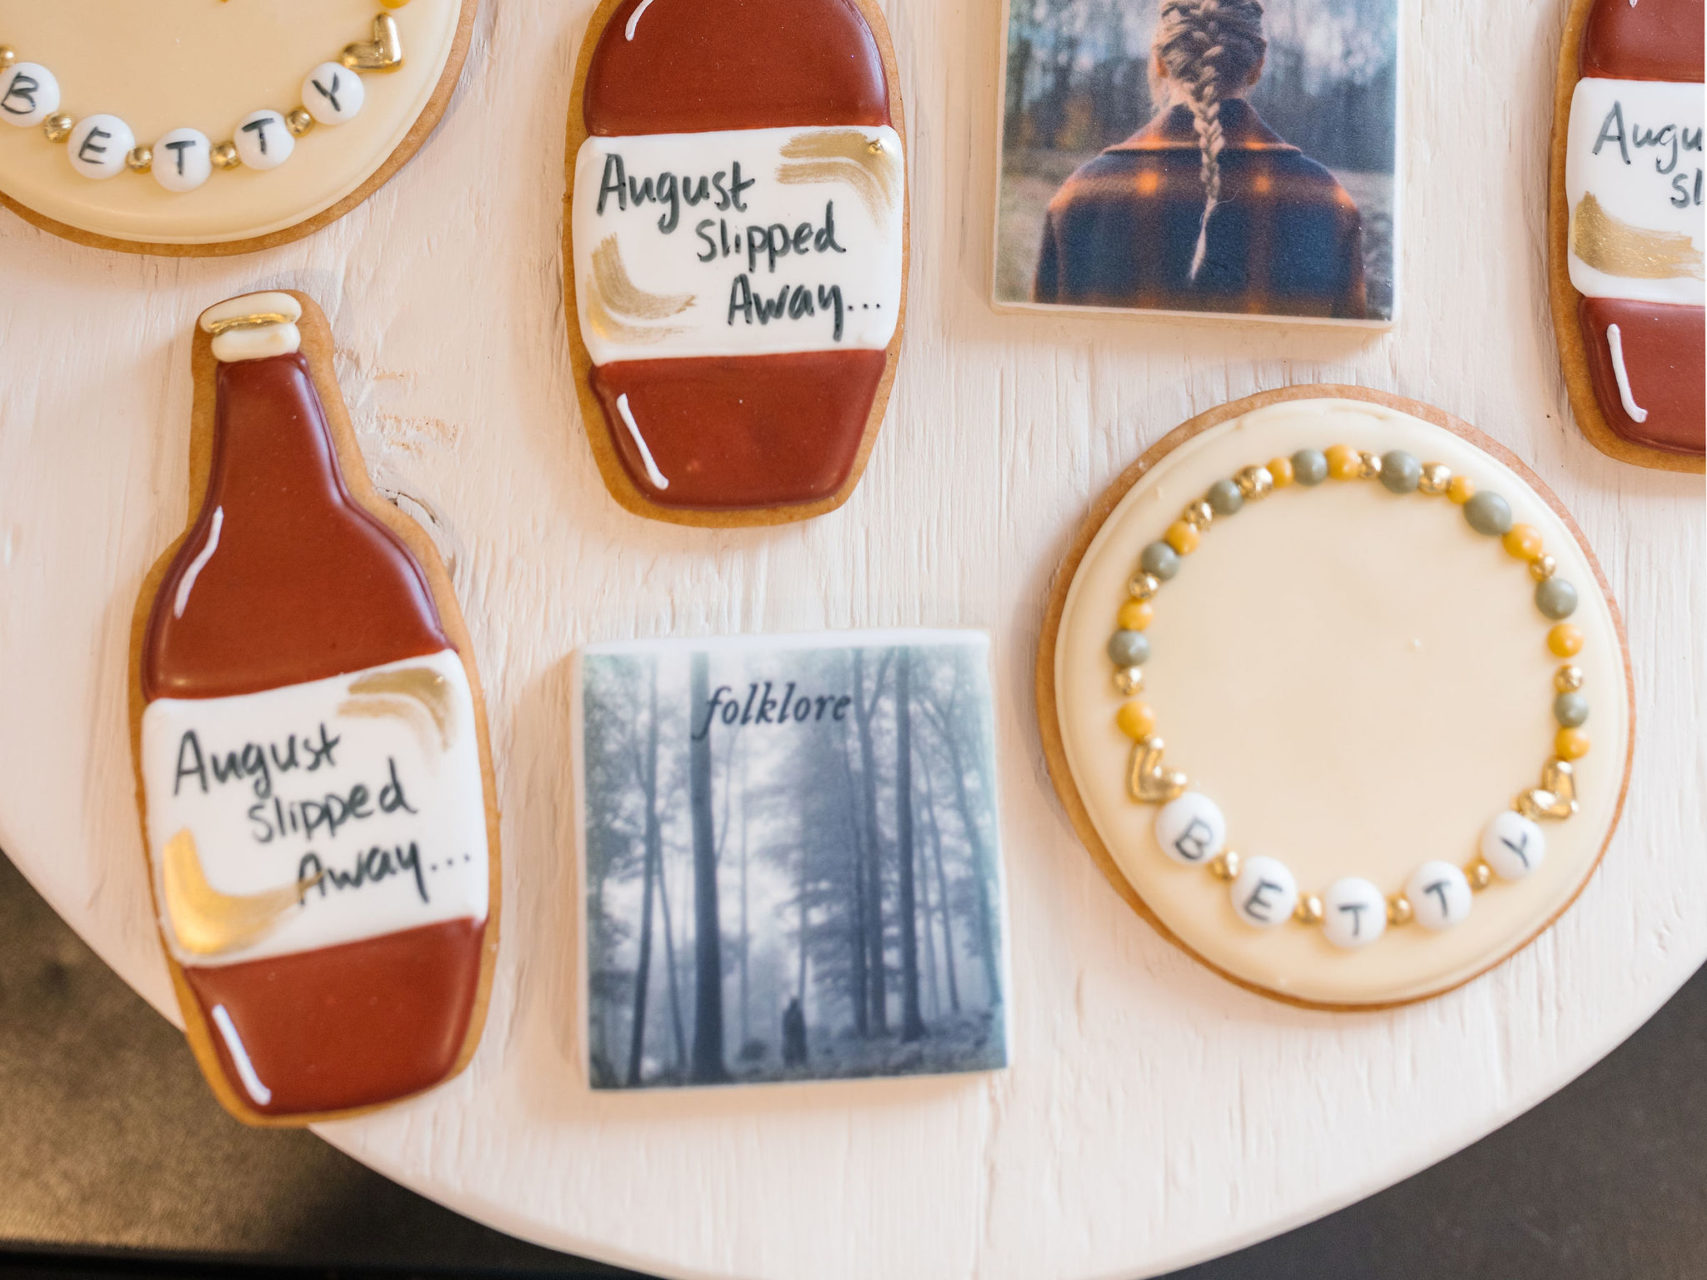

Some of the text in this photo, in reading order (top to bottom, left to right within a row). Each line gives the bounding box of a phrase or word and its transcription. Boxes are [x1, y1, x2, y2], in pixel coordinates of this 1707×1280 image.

[1, 71, 342, 176] BETTY
[597, 153, 756, 235] August
[691, 683, 852, 740] folklore
[174, 722, 341, 800] August
[1173, 816, 1541, 937] BETTY
